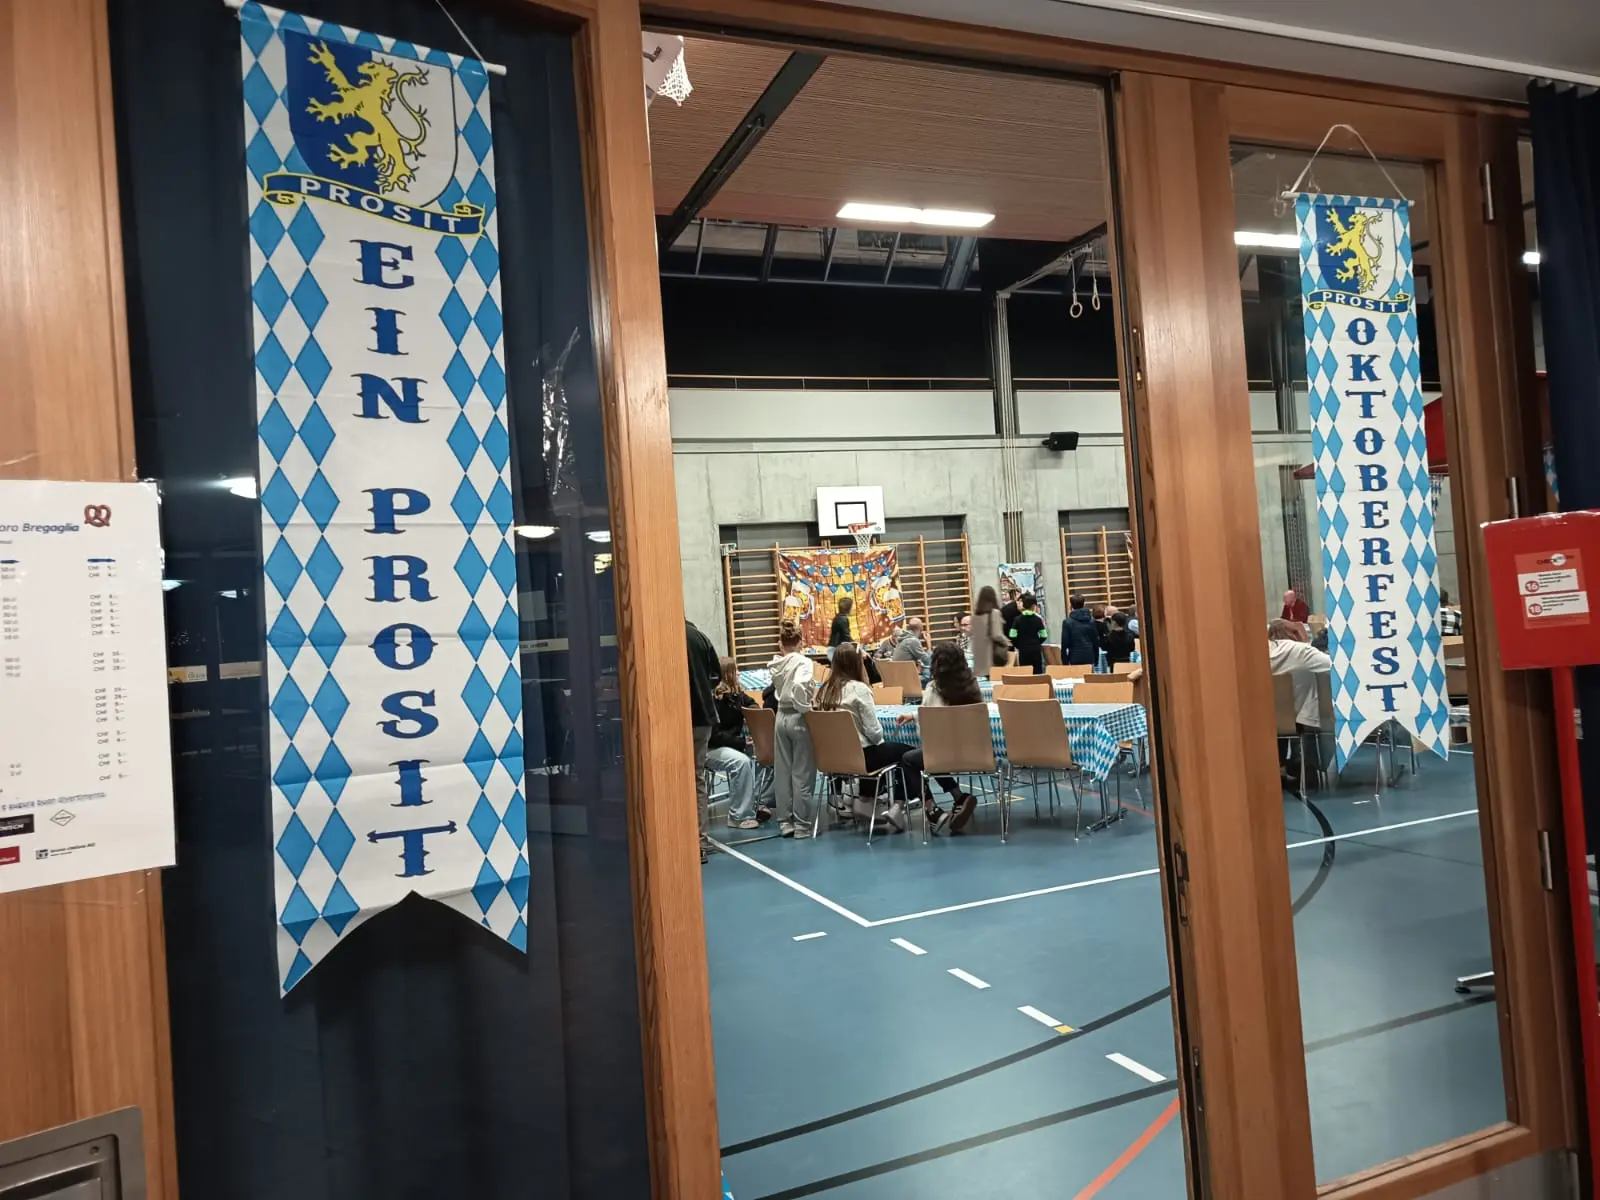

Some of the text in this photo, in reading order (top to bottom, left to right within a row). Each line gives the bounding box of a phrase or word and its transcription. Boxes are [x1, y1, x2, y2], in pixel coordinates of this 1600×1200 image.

[299, 177, 461, 233] PROSIT
[1322, 291, 1399, 313] PROSIT
[22, 522, 80, 534] Bregaglia
[1345, 317, 1408, 712] OKTOBERFEST
[349, 239, 458, 878] EIN PROSIT
